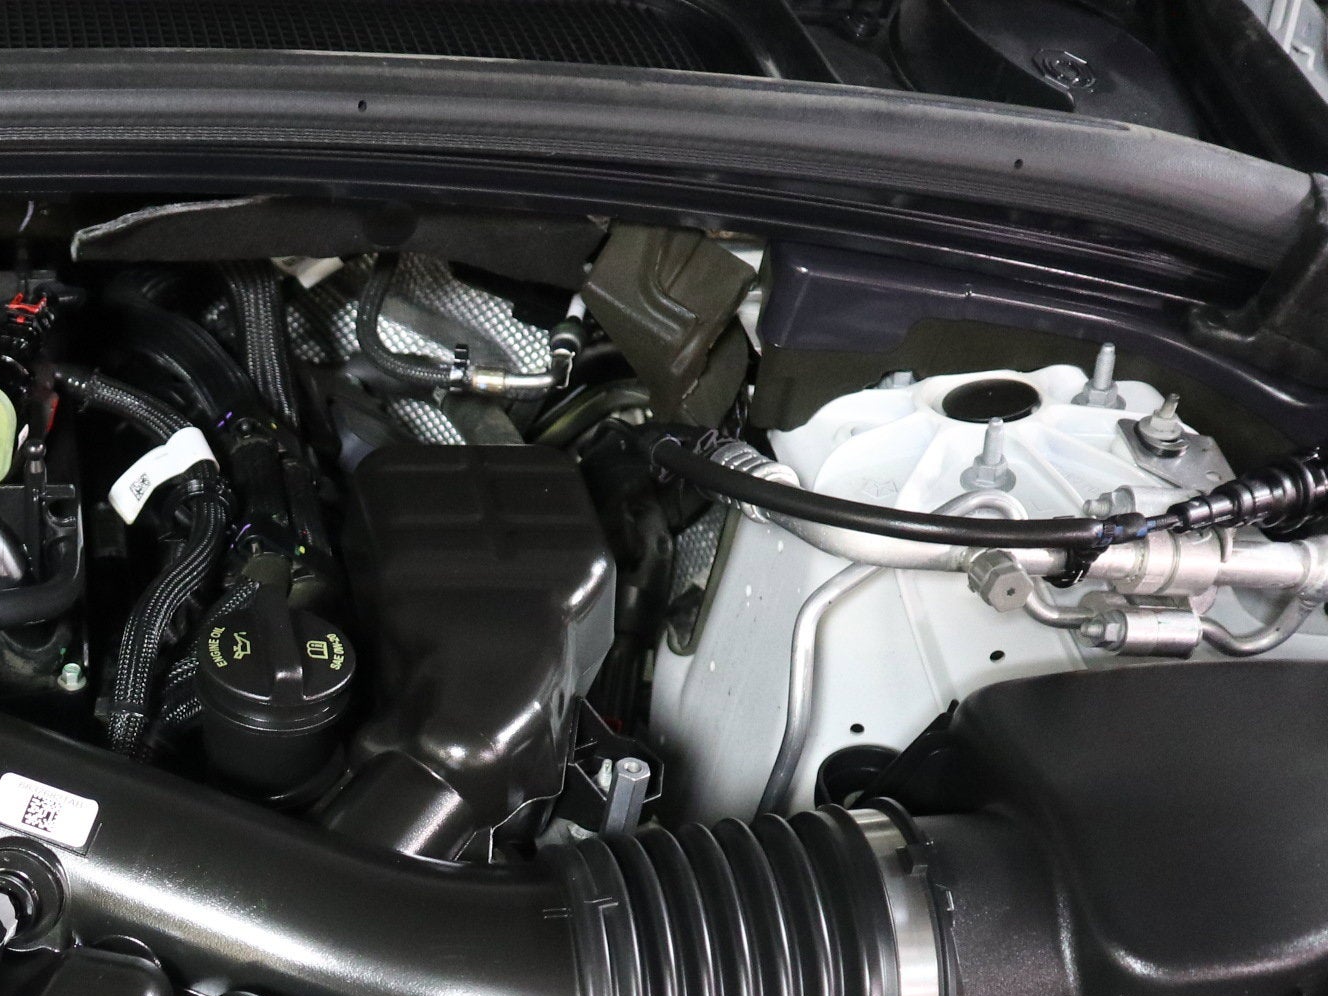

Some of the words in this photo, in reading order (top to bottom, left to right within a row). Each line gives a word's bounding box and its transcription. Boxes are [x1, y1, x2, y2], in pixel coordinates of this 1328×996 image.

[211, 627, 226, 638] OIL
[208, 638, 228, 668] ENGINE
[326, 633, 345, 655] 0W-20
[329, 654, 345, 671] SAE
